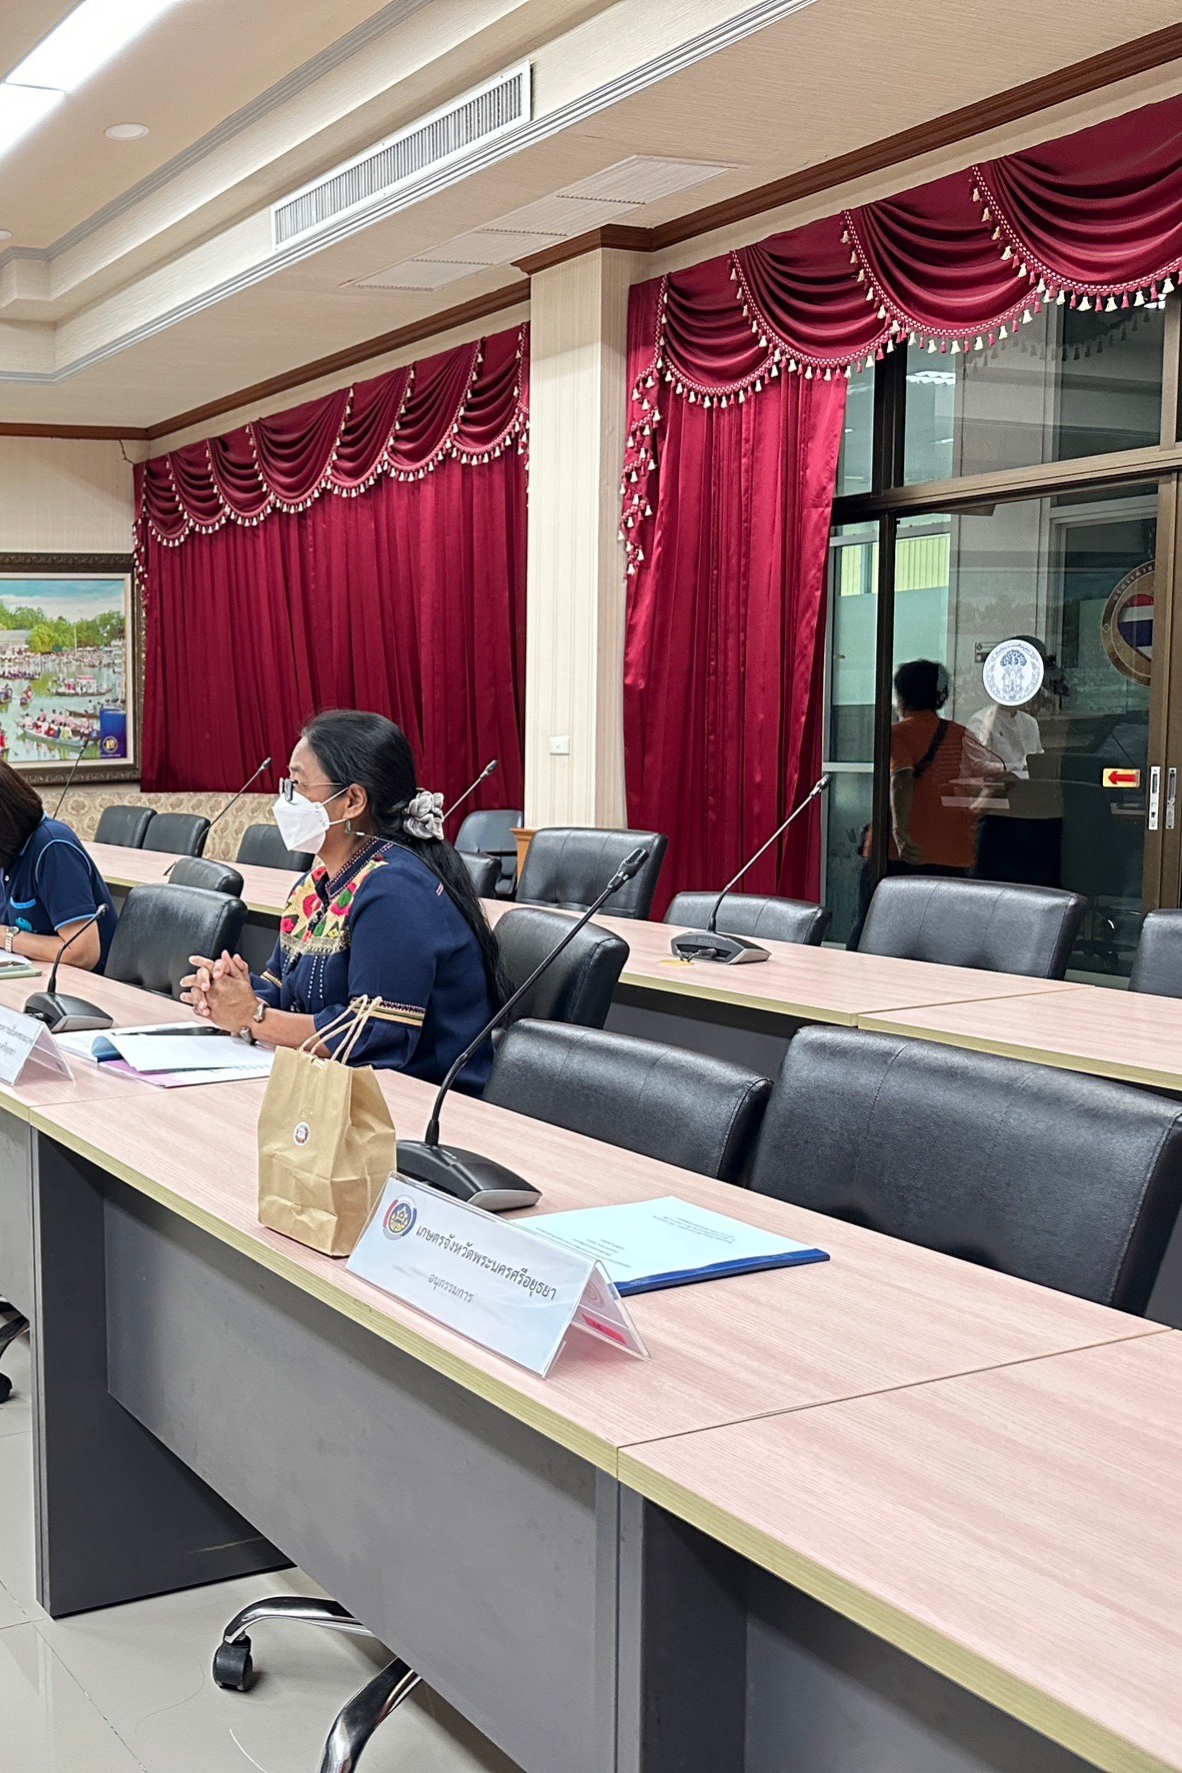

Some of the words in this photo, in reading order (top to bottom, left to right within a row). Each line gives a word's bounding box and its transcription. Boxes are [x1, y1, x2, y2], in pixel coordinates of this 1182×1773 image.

[416, 1225, 557, 1300] เกษตรจังหวัดพระนครศรีอยุธยา
[427, 1273, 474, 1304] อนุกรรมการ
